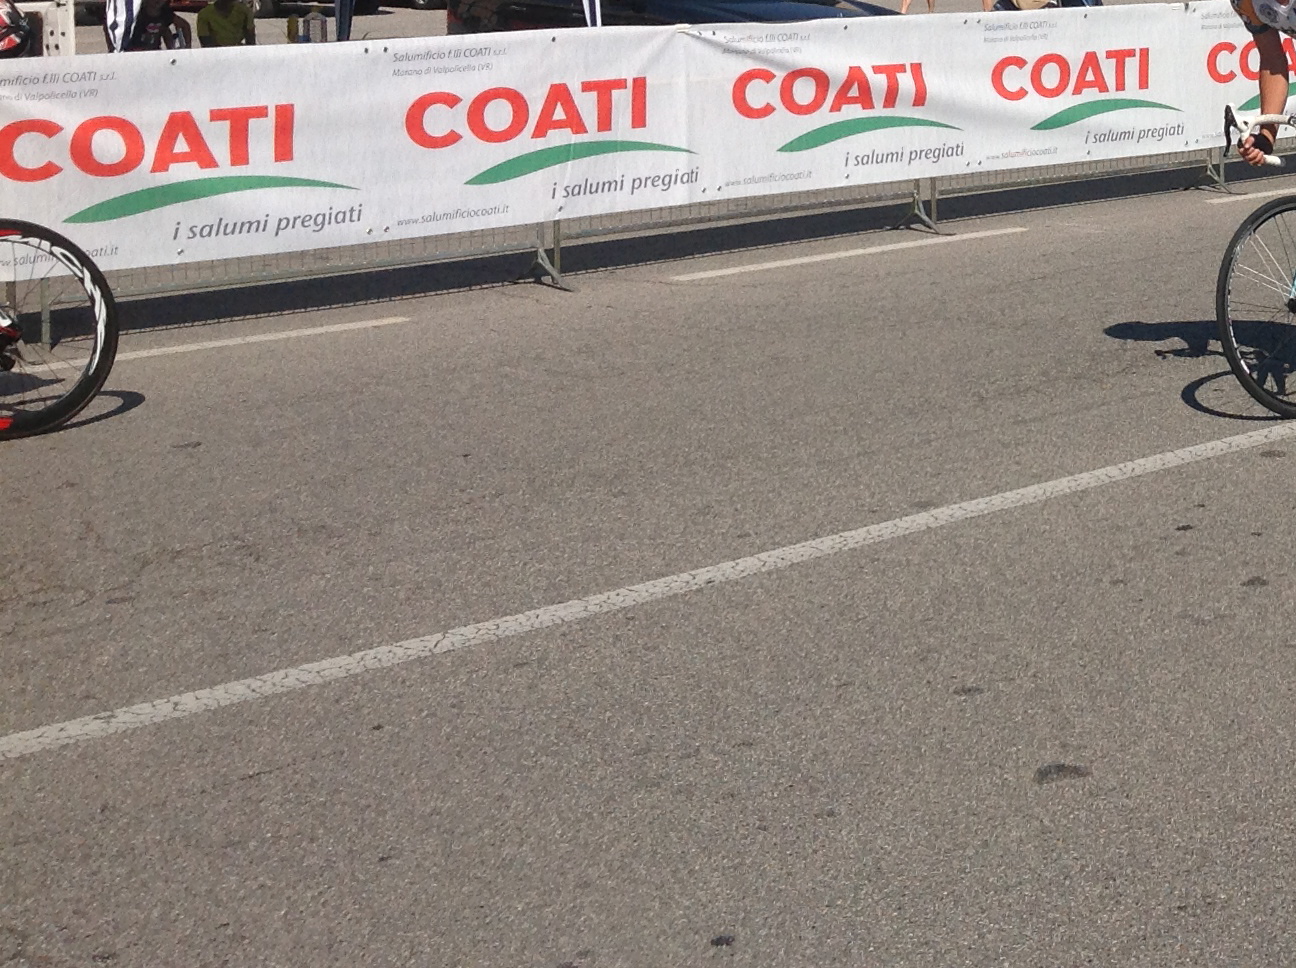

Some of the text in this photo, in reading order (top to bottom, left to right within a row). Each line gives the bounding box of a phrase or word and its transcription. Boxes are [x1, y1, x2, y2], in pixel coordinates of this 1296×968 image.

[393, 50, 445, 62] Salumificio
[463, 47, 491, 58] COATI
[63, 71, 97, 83] COATI
[731, 62, 927, 119] COATI
[991, 48, 1149, 101] COATI
[404, 76, 647, 149] COATI
[0, 103, 294, 182] COATI
[1085, 131, 1090, 145] i
[1092, 128, 1134, 144] salumi
[1137, 123, 1185, 144] pregiati
[845, 142, 964, 167] i salumi pregiati
[552, 167, 699, 199] i salumi pregiati
[173, 204, 363, 240] i salumi pregiati
[397, 205, 509, 227] www.salumificiocoati.it
